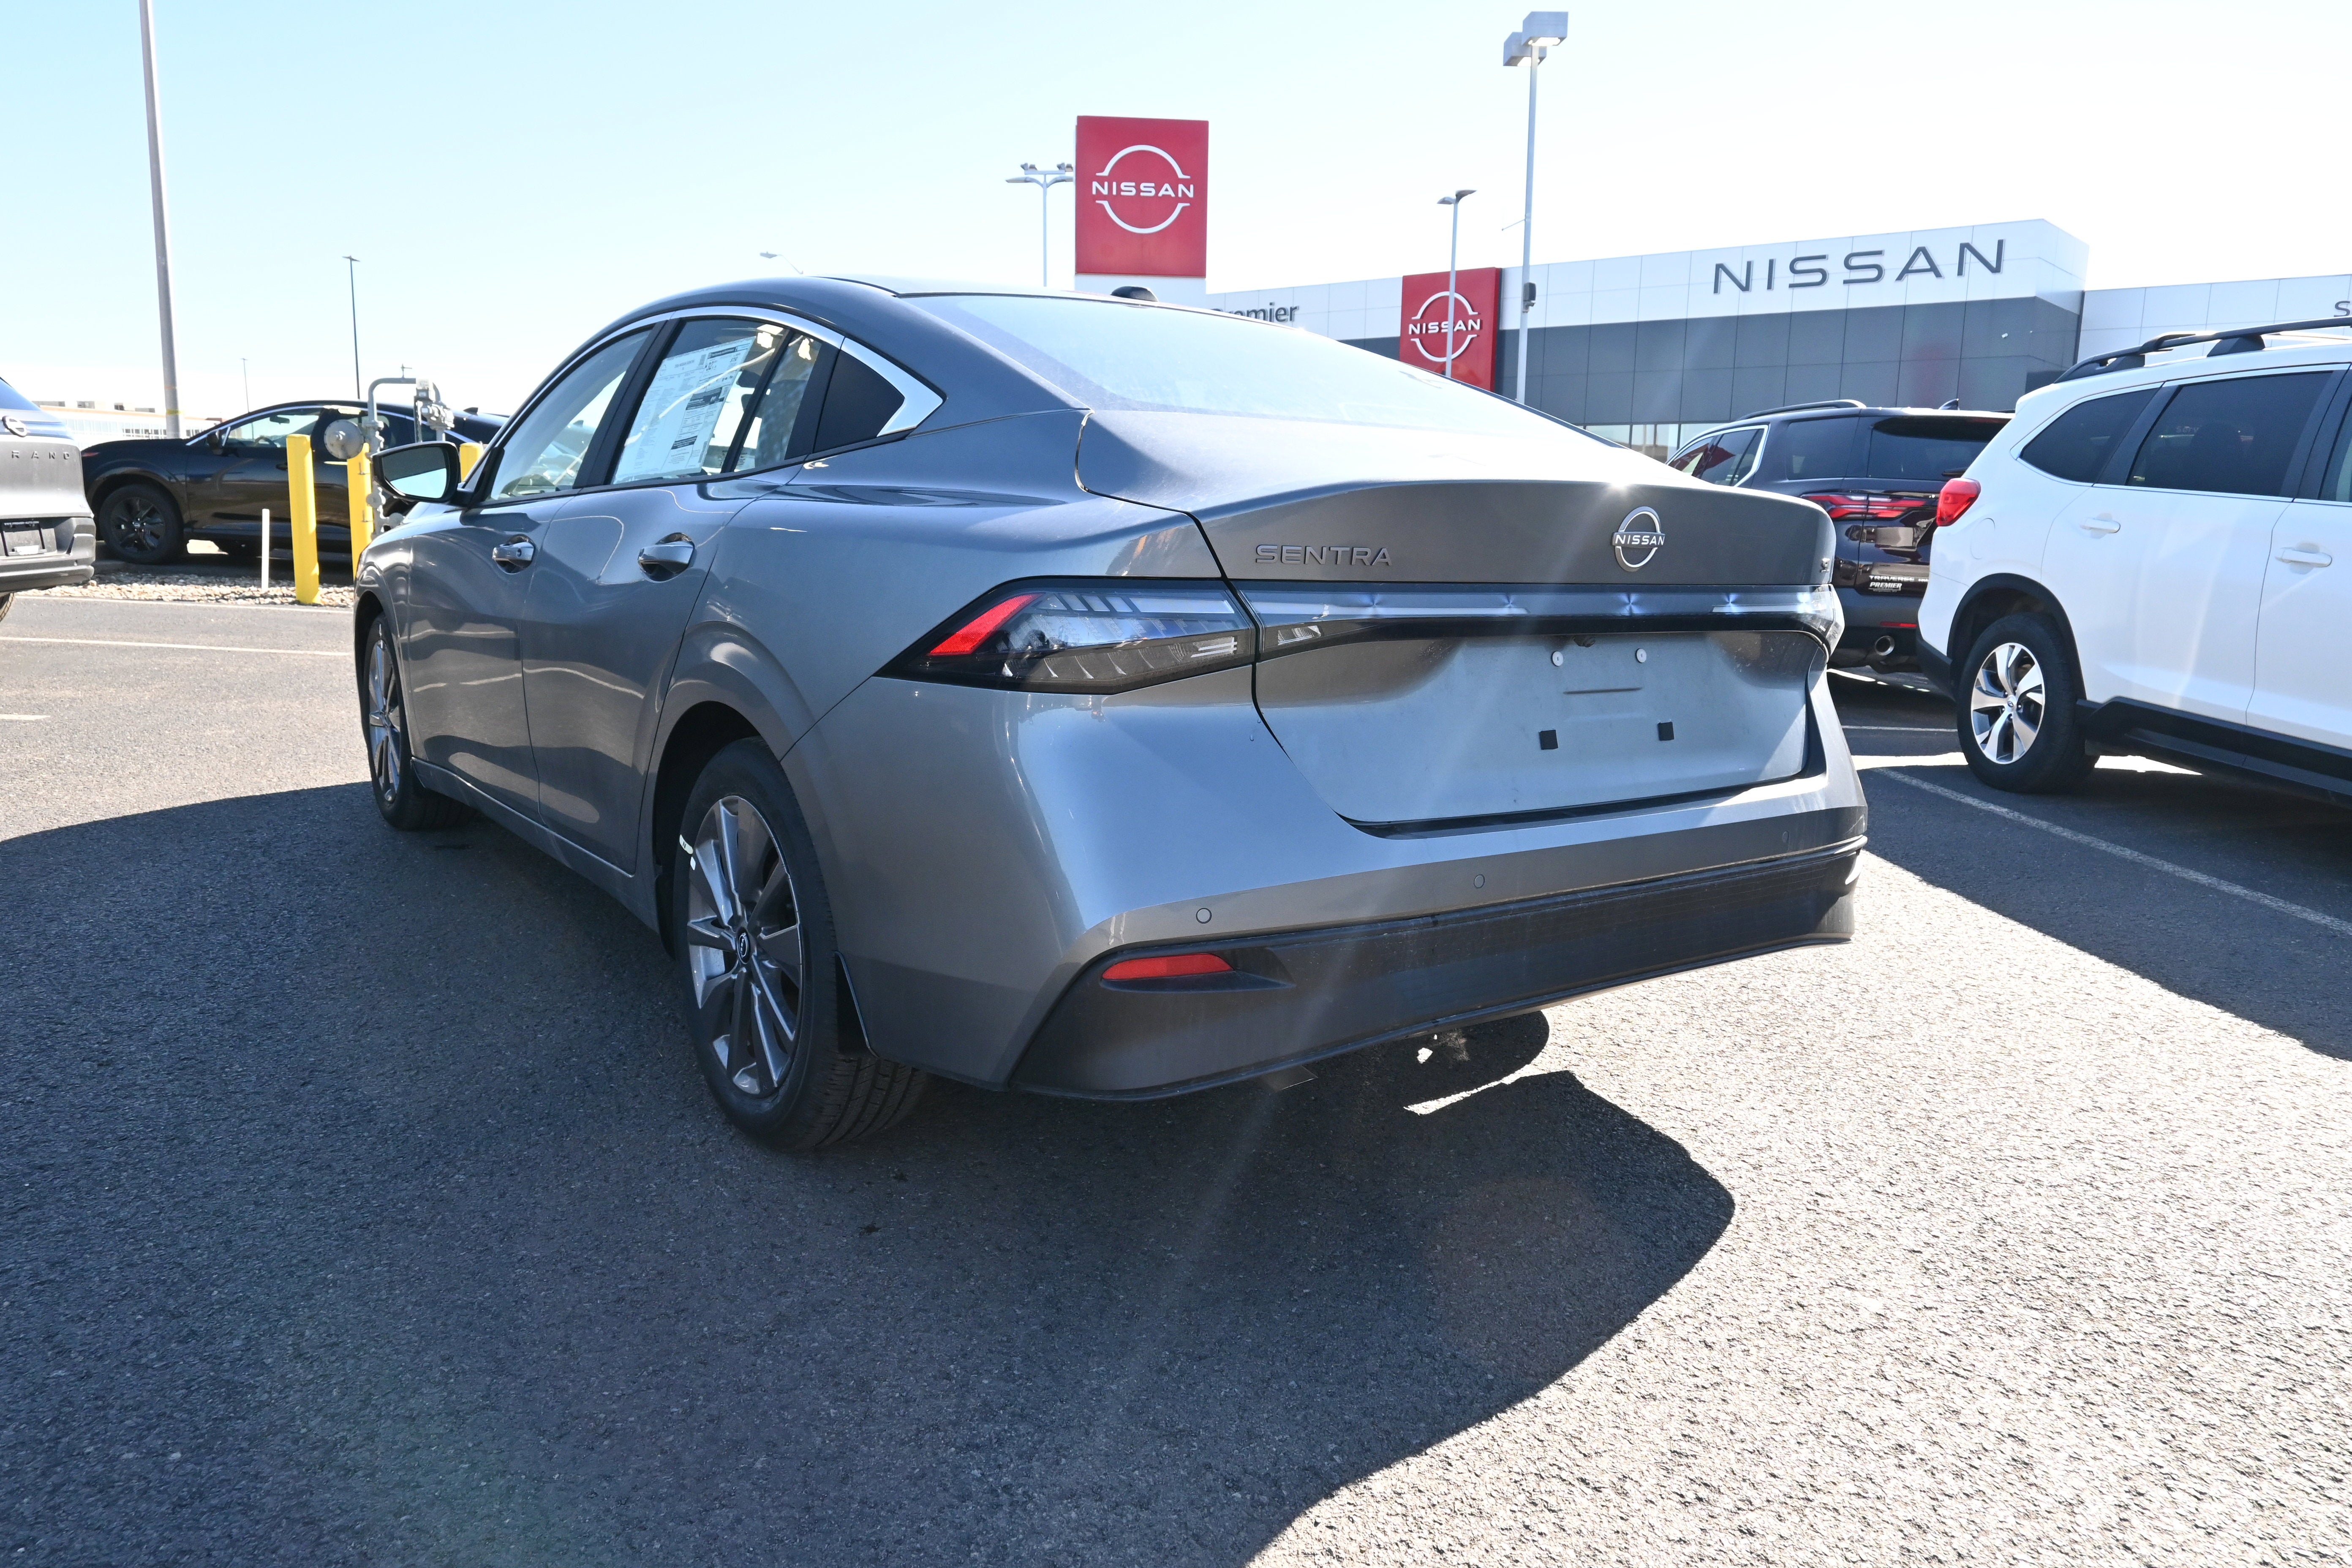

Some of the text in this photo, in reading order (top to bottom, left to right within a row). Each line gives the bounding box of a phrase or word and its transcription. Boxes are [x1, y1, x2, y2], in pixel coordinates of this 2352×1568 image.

[1092, 181, 1194, 198] NISSAN
[1713, 239, 2005, 294] NISSAN
[1409, 318, 1481, 335] NISSAN
[1615, 534, 1665, 546] NISSAN
[1255, 544, 1393, 566] SENTRA
